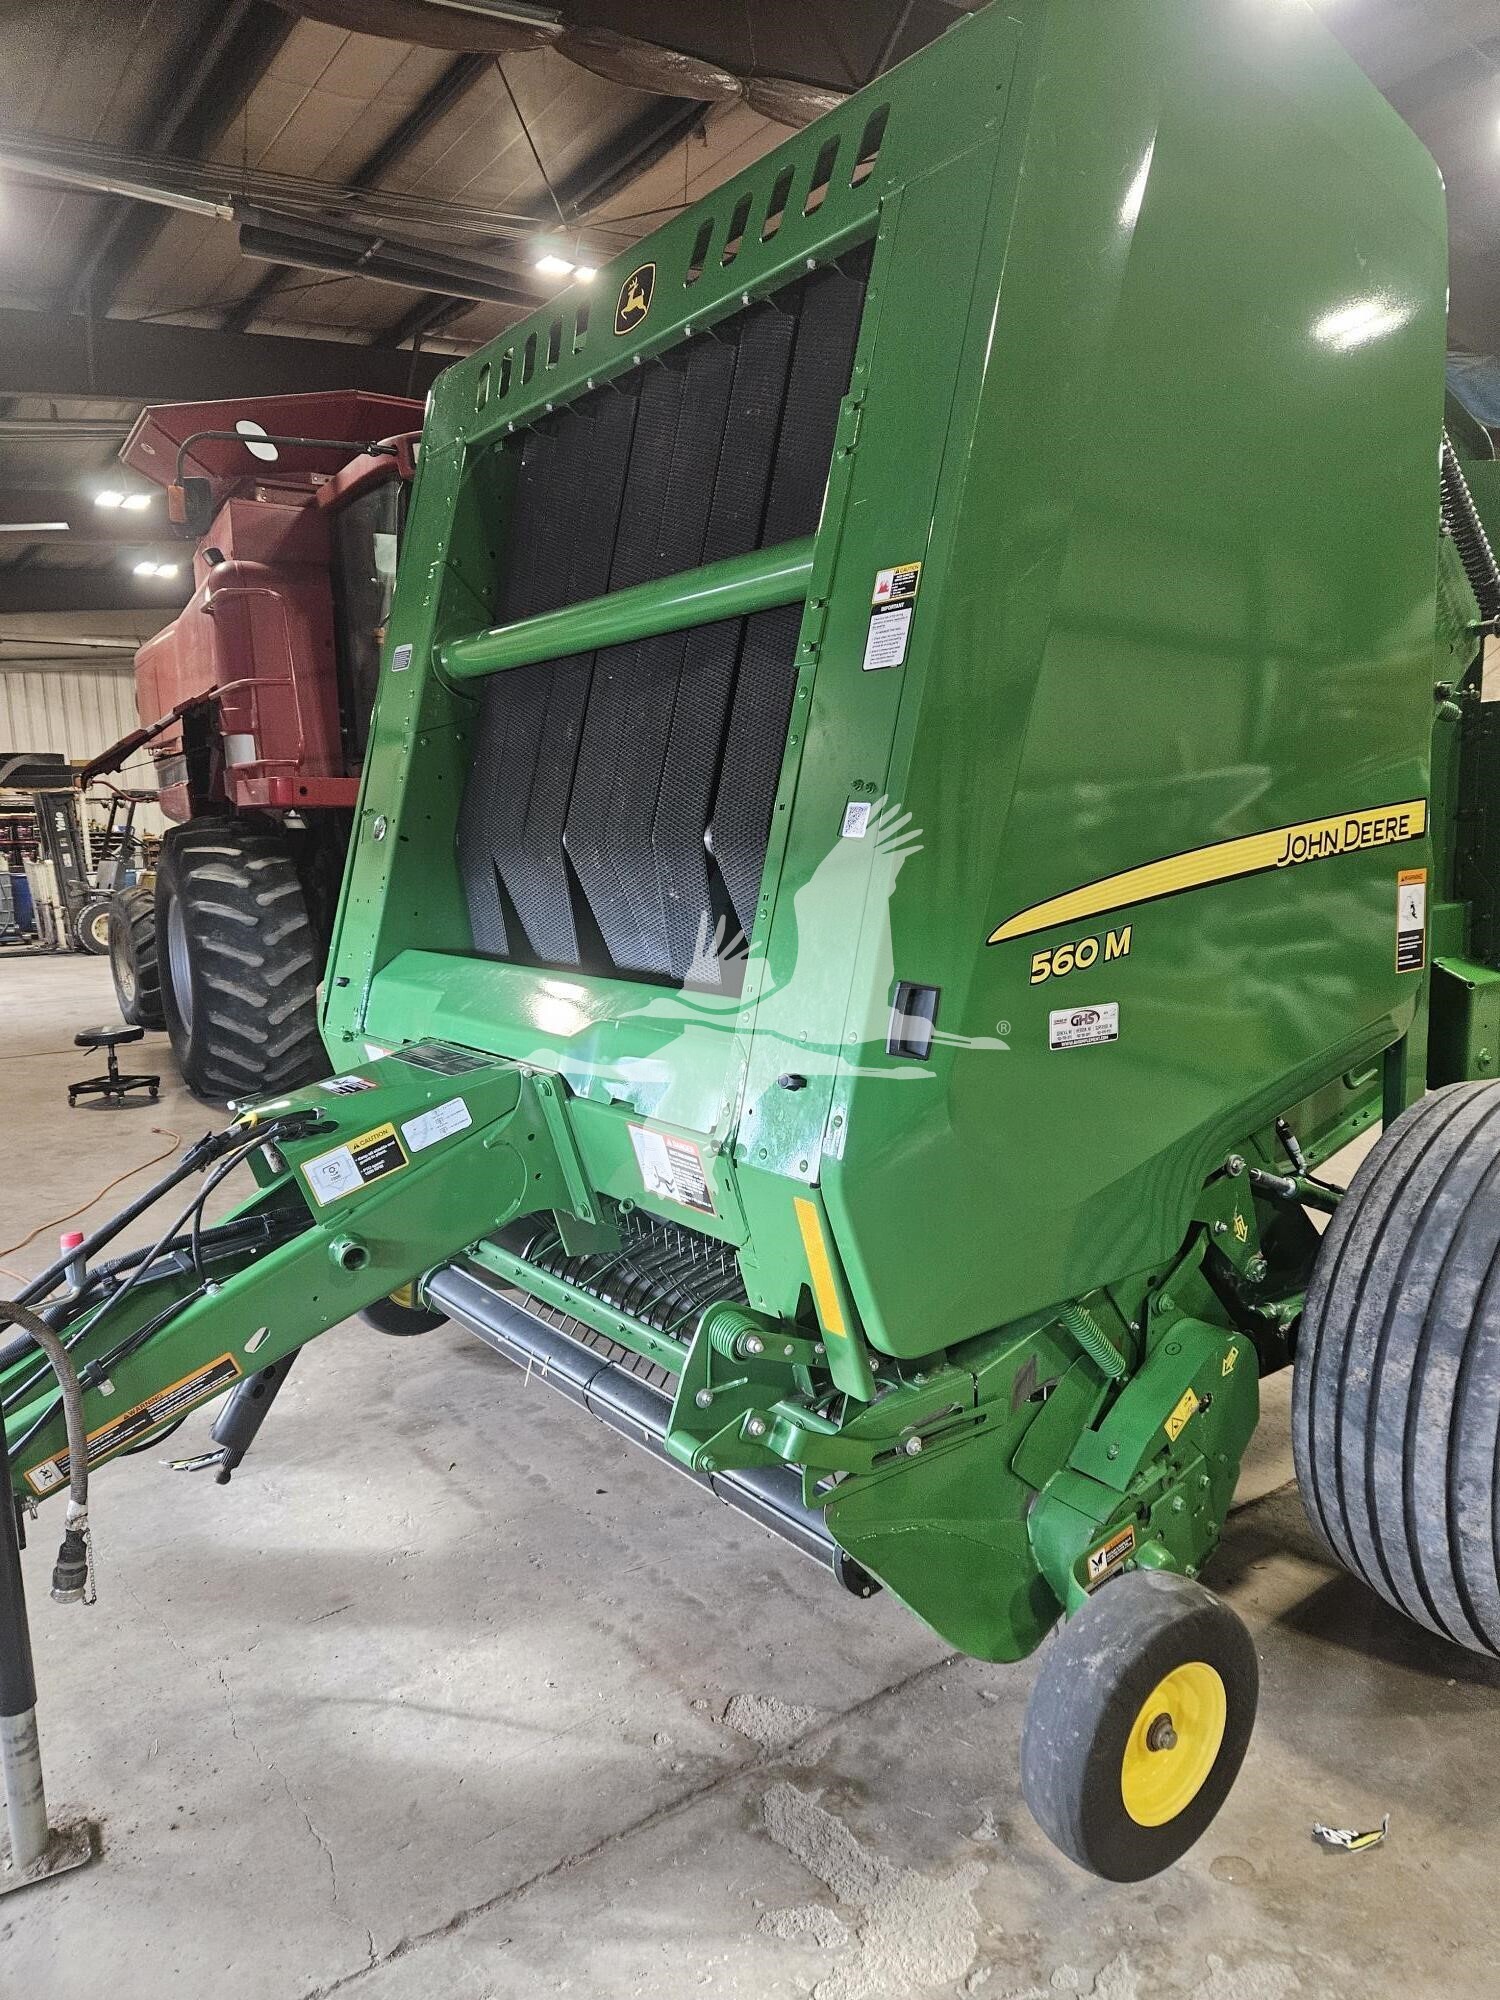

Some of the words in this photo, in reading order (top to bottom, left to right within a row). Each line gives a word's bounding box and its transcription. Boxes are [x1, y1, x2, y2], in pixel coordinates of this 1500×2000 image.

[1277, 828, 1338, 864] JOHN
[1344, 815, 1410, 848] DEERE
[1030, 936, 1100, 985] 560
[1103, 924, 1133, 963] M
[1070, 1013, 1096, 1027] GHS
[359, 1129, 388, 1146] CAUTION
